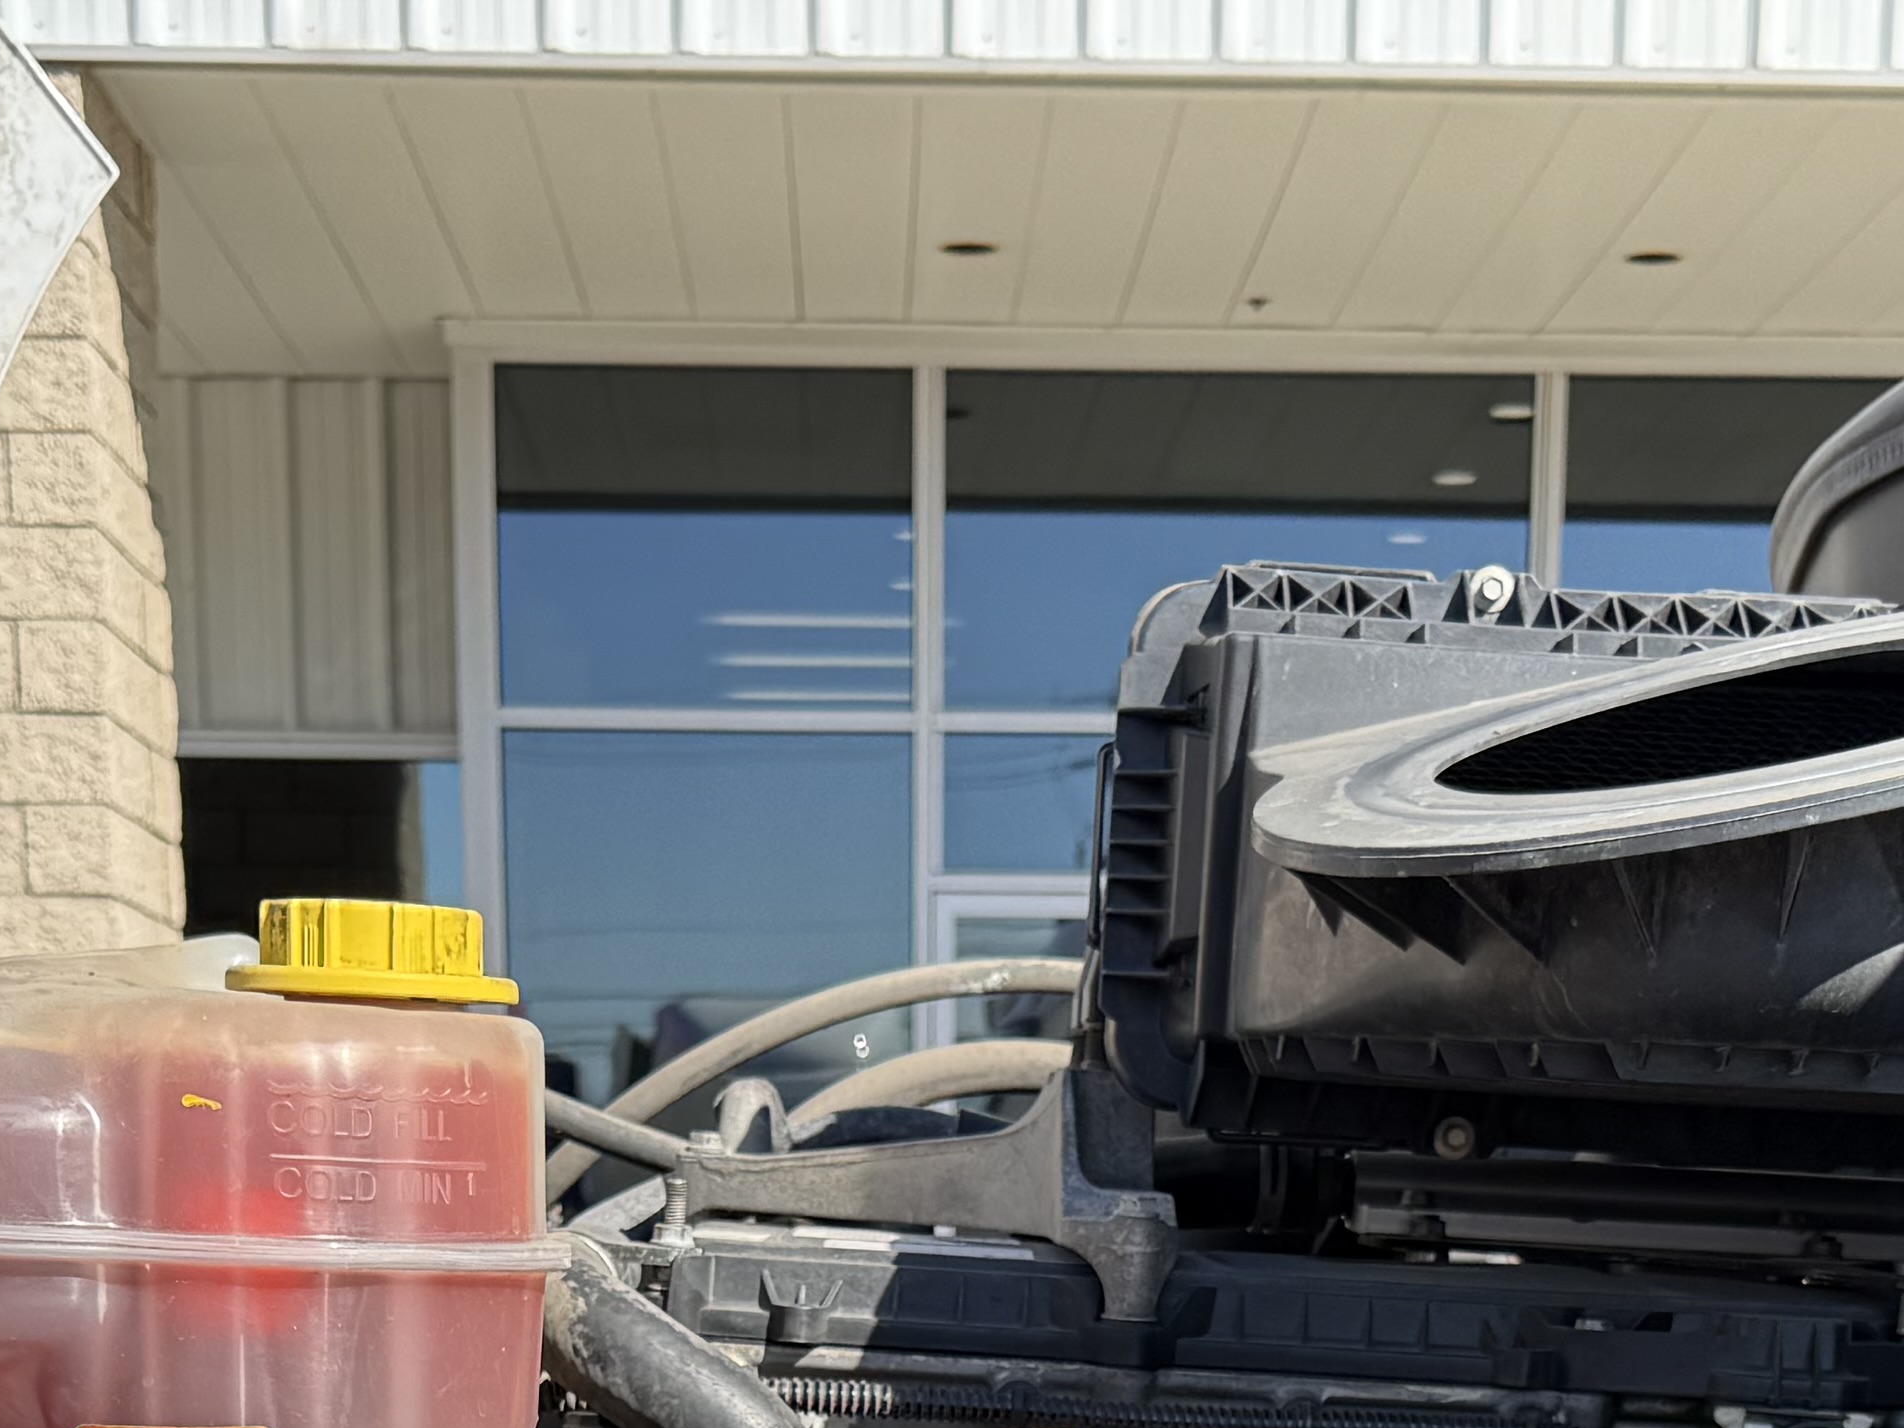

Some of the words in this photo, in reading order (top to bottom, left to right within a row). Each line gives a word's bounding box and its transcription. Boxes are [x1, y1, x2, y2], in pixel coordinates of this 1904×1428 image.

[267, 1100, 373, 1139] COLD
[394, 1104, 453, 1142] FILL
[274, 1166, 377, 1201] COLD
[398, 1168, 451, 1205] MIN
